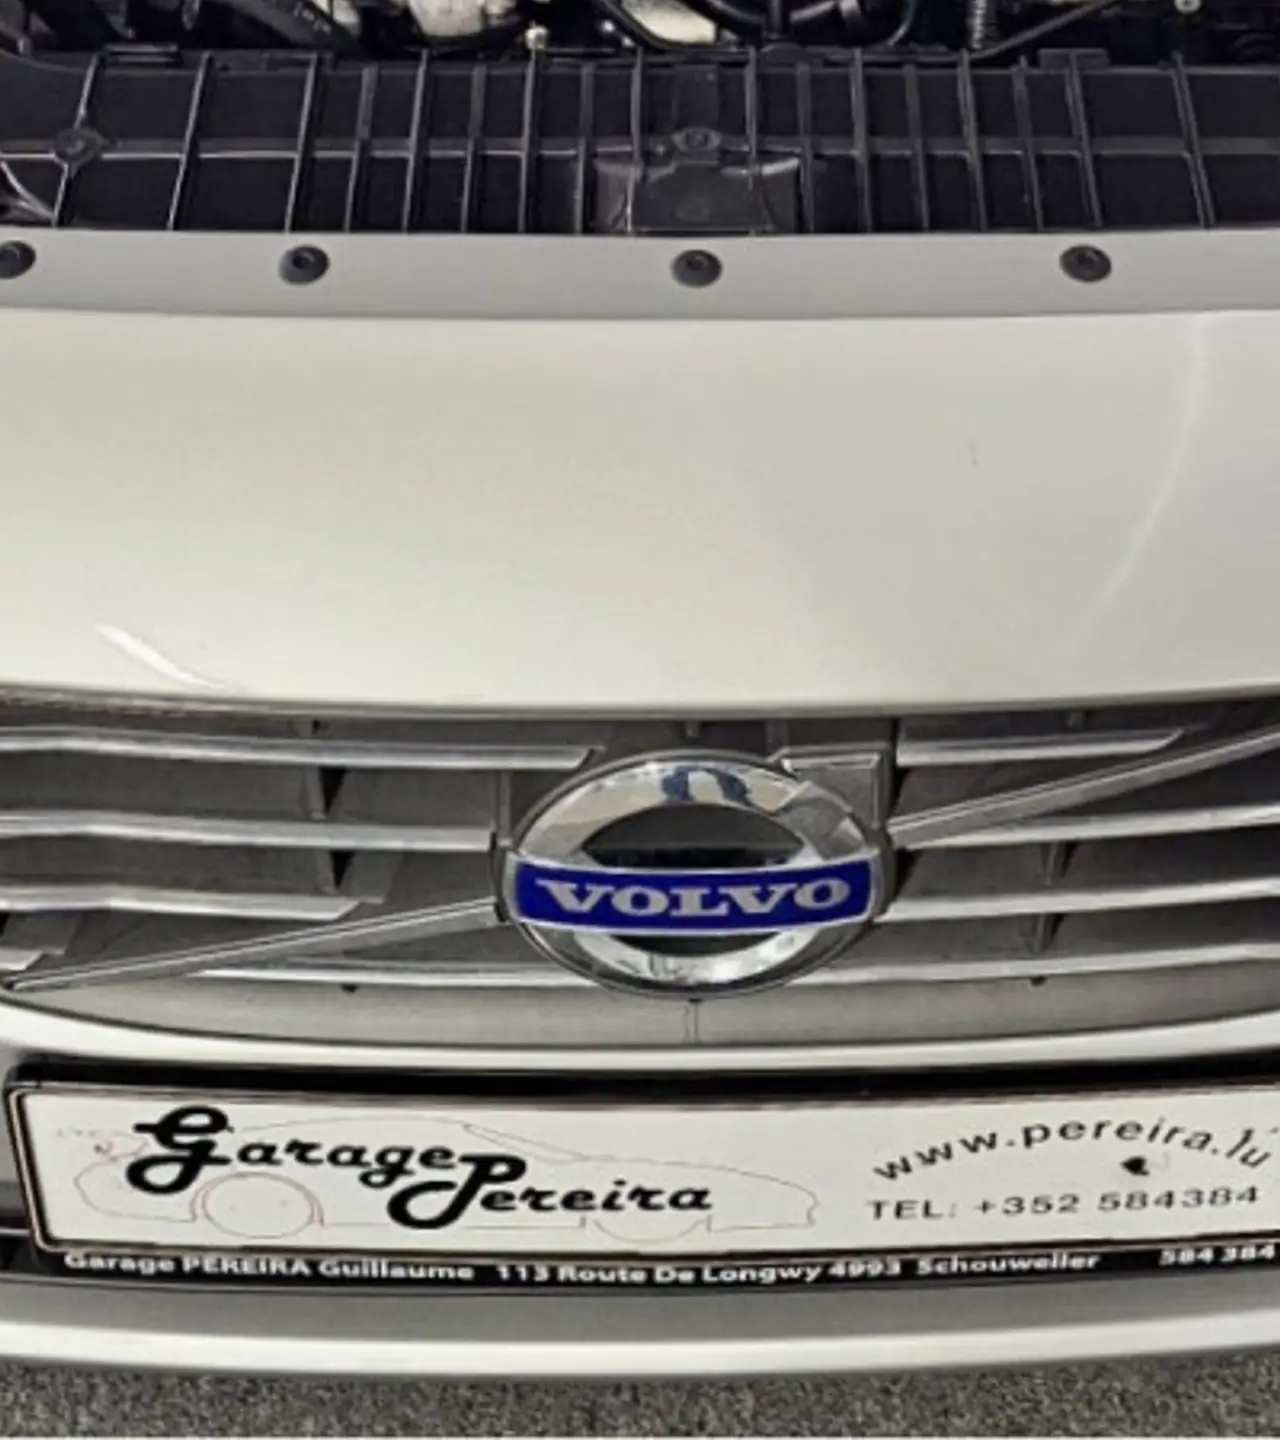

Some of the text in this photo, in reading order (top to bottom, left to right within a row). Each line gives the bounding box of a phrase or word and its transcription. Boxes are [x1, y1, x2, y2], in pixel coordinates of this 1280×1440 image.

[535, 877, 850, 917] VOLVO
[125, 1105, 456, 1195] Garage
[872, 1117, 1272, 1181] www.pereira.lu
[387, 1153, 714, 1230] Pereira
[867, 1185, 1260, 1220] TEL: +352 584384
[64, 1253, 175, 1275] Garage
[183, 1256, 311, 1276] PEREIRA
[318, 1258, 475, 1280] Guillaume
[496, 1264, 553, 1282] 113
[557, 1264, 646, 1284] Route
[655, 1265, 695, 1284] De
[702, 1262, 821, 1287] Longwy
